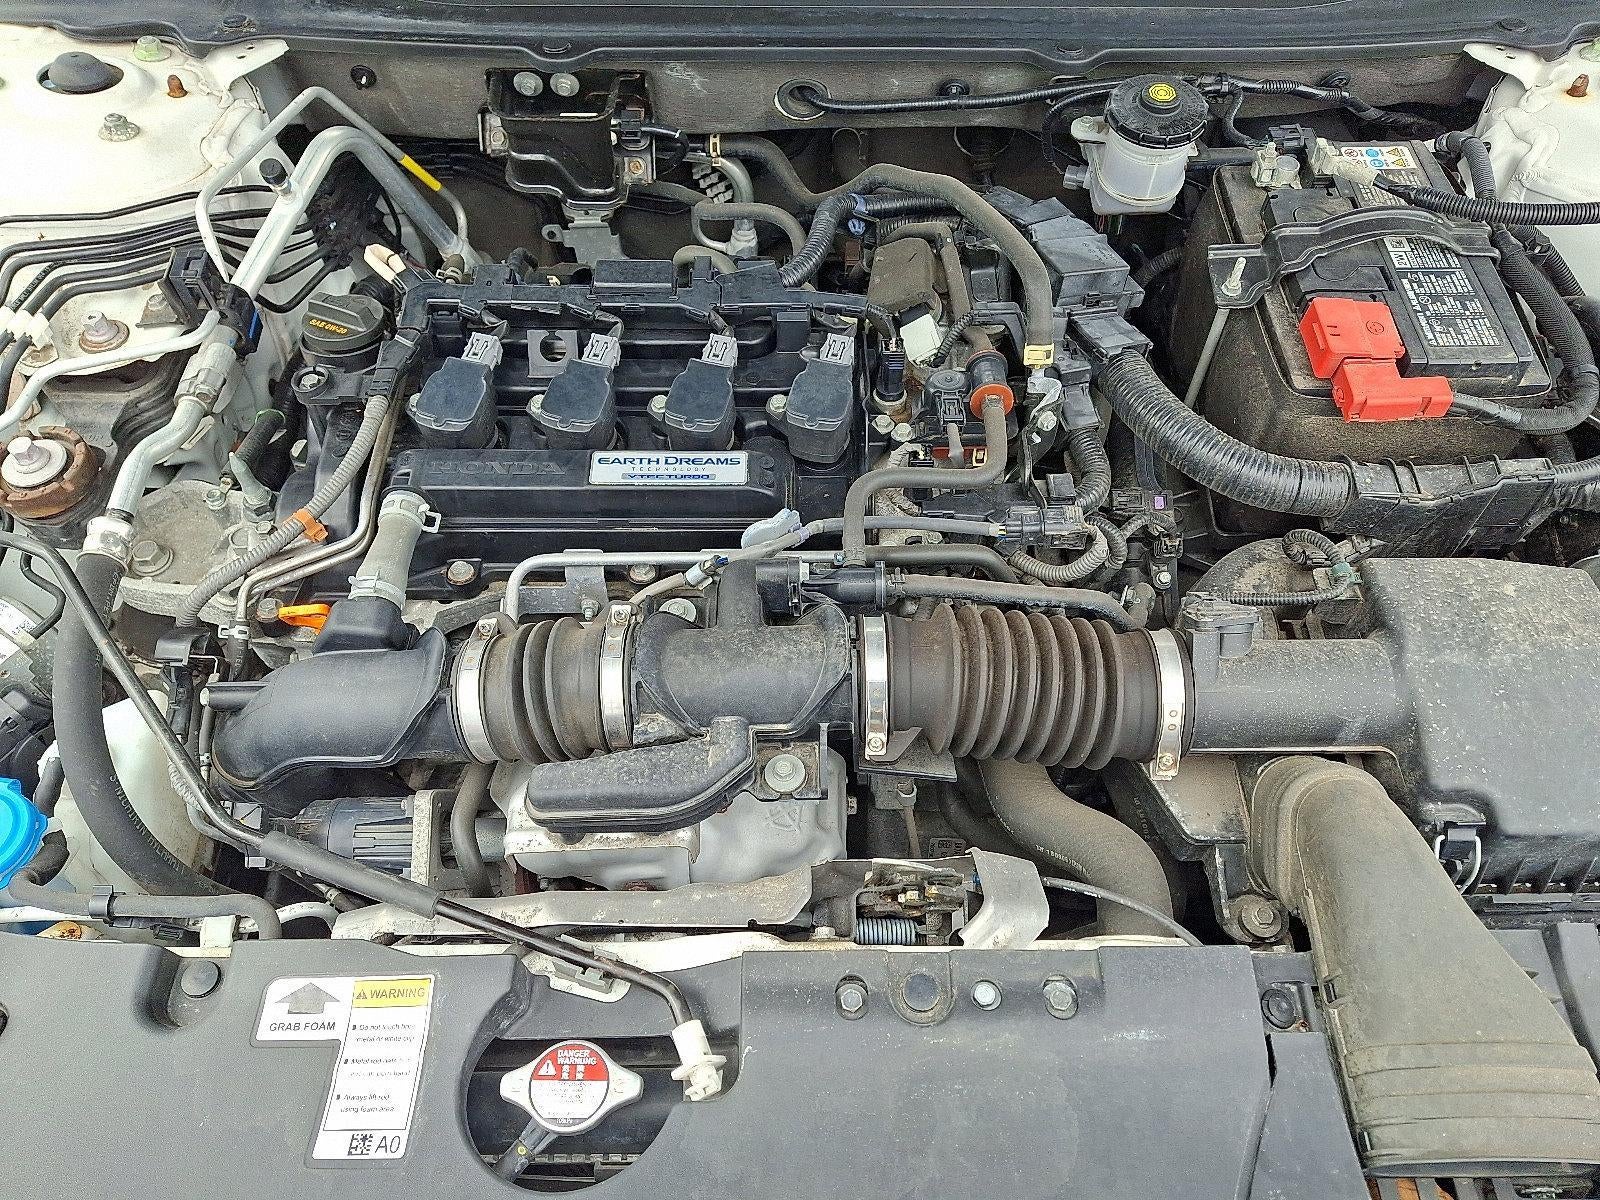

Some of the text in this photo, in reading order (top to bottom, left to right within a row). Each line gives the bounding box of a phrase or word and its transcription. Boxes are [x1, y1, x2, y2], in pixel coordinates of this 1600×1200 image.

[309, 319, 326, 329] SAE
[597, 455, 741, 467] EARTH DREAMS
[429, 460, 566, 476] HONDA
[370, 987, 426, 999] WARNING
[269, 1021, 336, 1032] GRAB FOAM
[557, 1049, 591, 1058] DANGER
[557, 1057, 598, 1066] WARNING
[374, 1135, 401, 1154] A0
